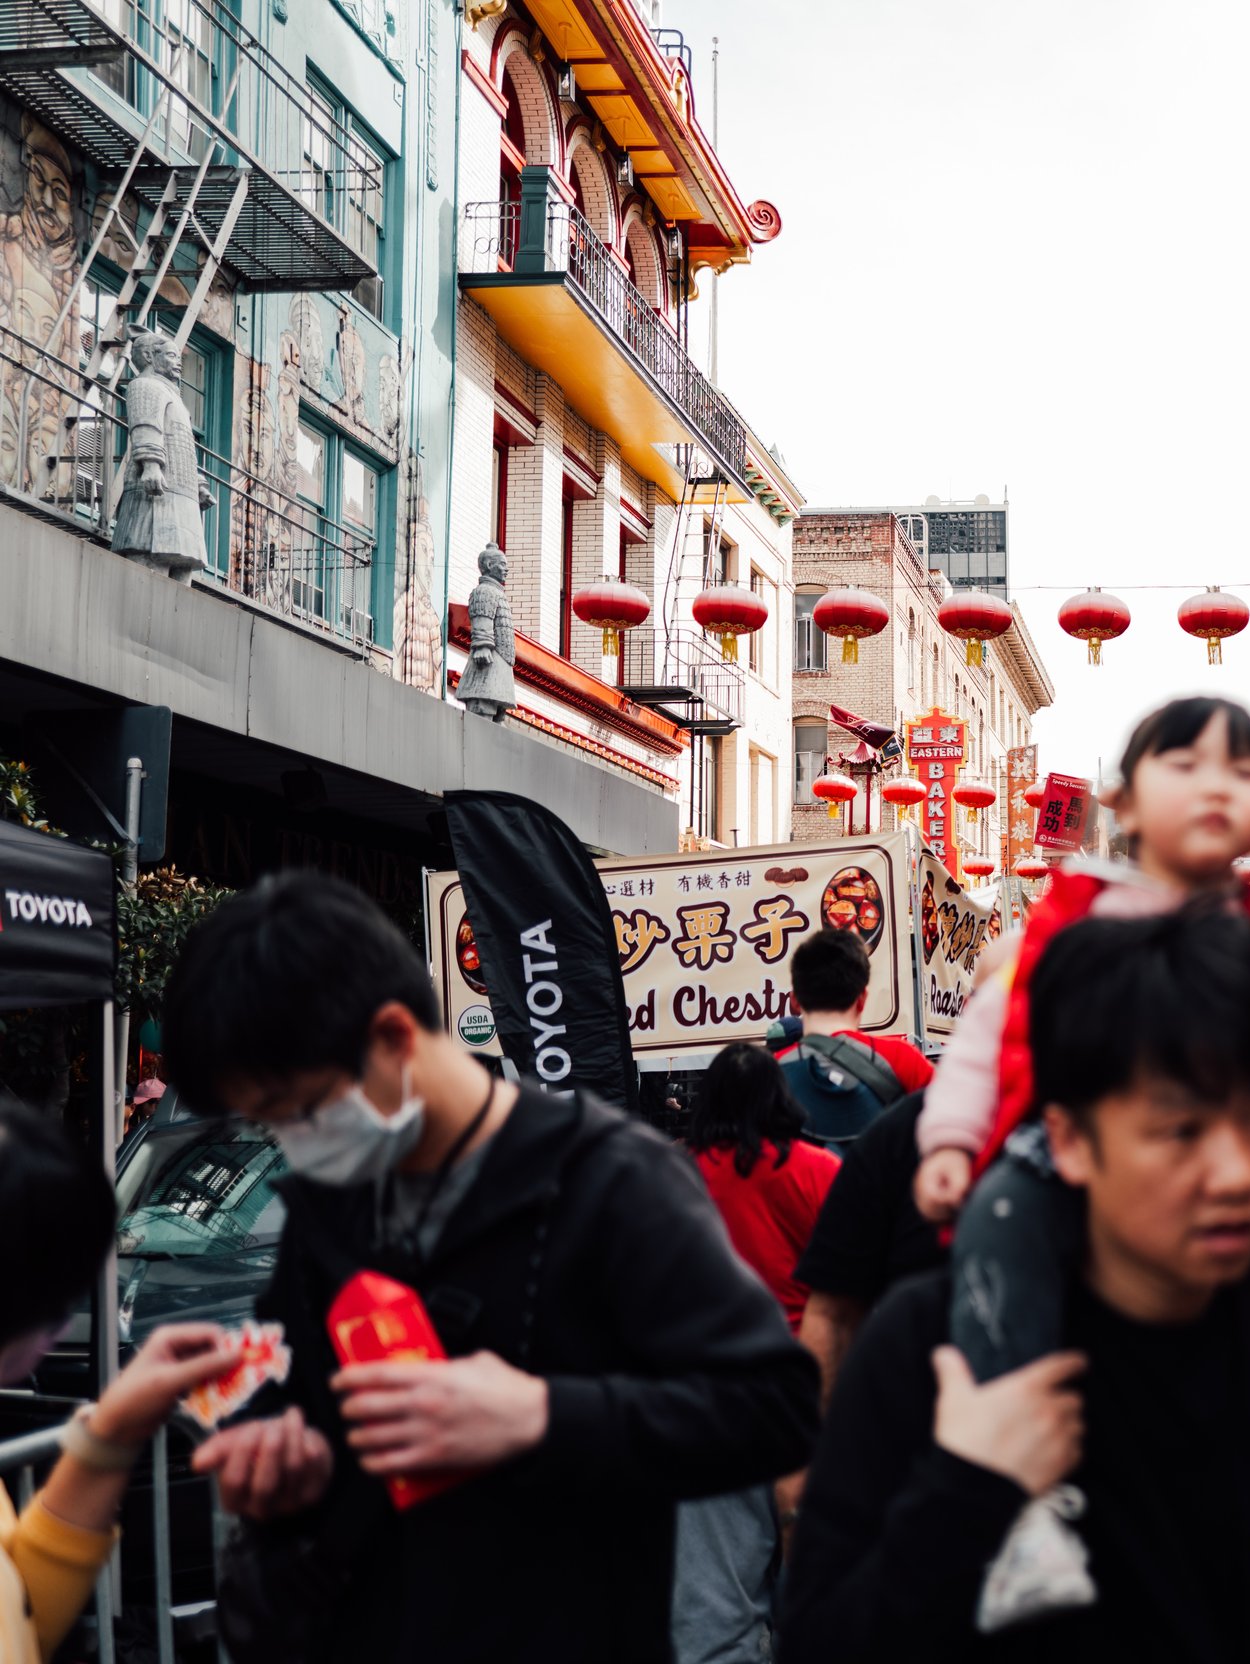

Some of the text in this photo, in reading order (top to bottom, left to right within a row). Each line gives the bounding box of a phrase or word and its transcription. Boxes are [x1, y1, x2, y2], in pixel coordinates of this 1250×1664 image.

[910, 747, 964, 758] EASTERN
[928, 762, 946, 862] BAKER
[604, 870, 752, 896] 心選材 有機香甜
[5, 889, 93, 928] TOYOTA
[612, 895, 811, 978] 炒栗子
[464, 1026, 492, 1036] ORGANIC
[466, 1015, 489, 1025] USDA
